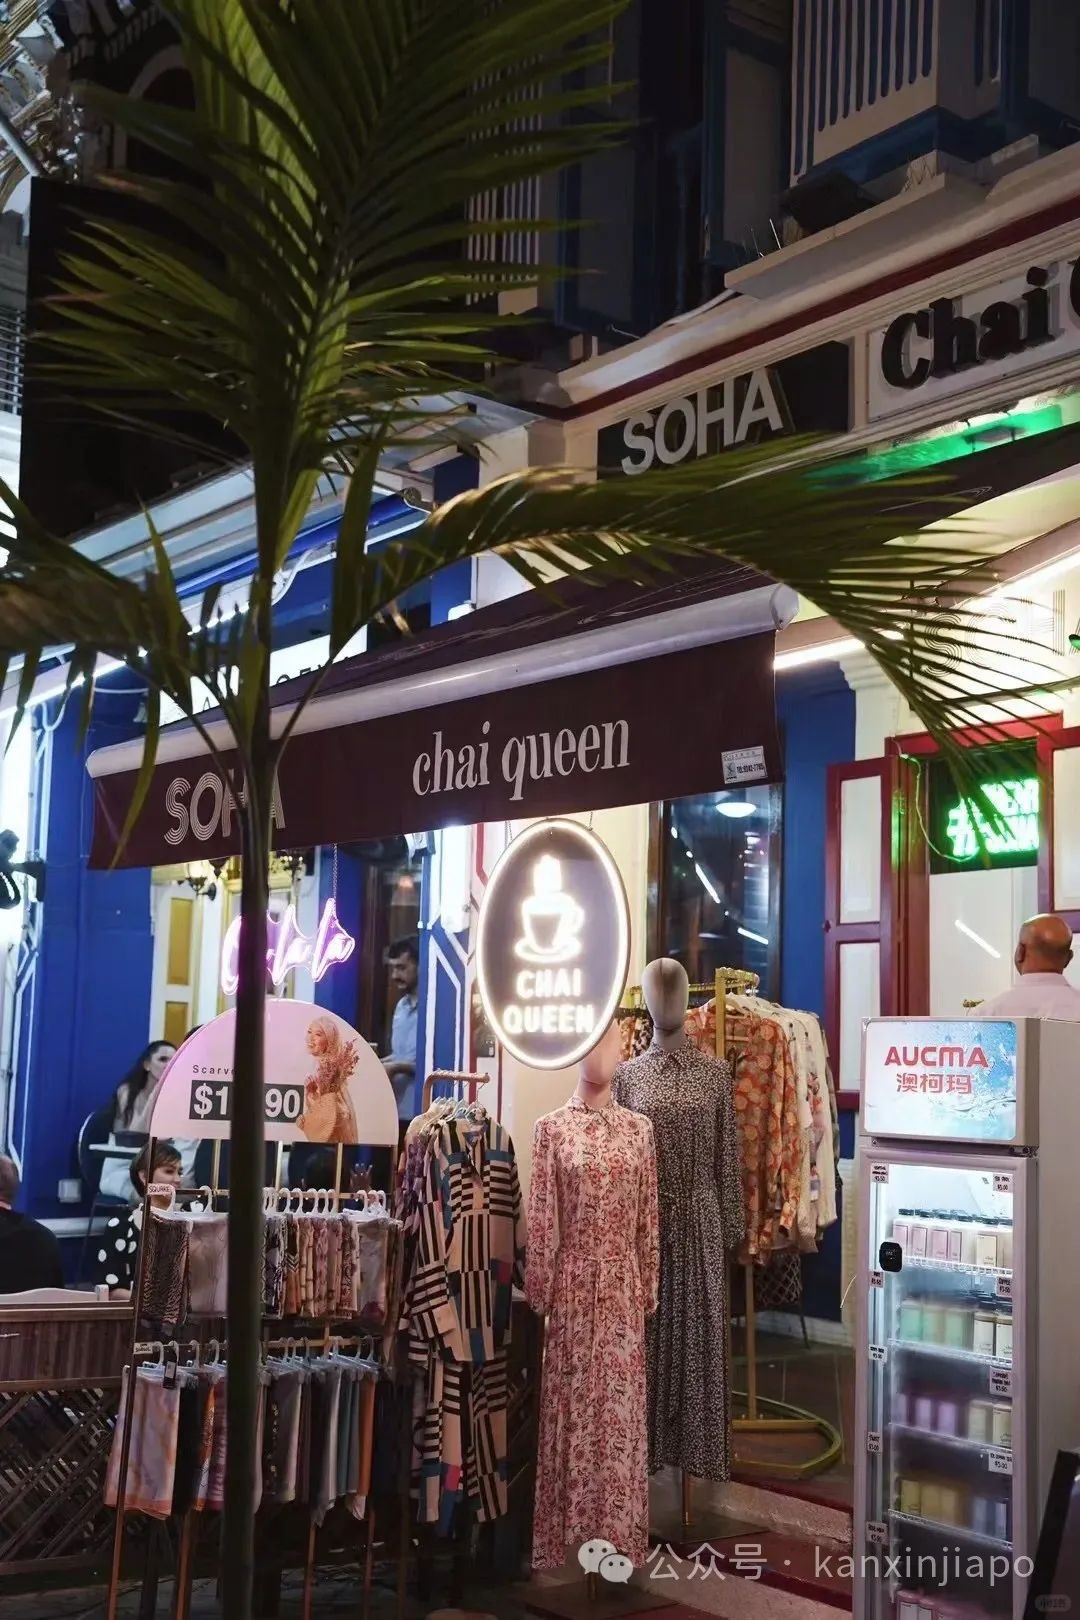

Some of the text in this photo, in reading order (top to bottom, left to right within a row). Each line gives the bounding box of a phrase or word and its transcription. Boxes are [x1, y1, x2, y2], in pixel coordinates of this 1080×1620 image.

[881, 266, 1057, 390] Chai
[621, 367, 784, 476] SOHA
[412, 719, 631, 801] chai queen
[516, 967, 582, 999] CHAI
[503, 1004, 595, 1034] QUEEN
[884, 1046, 989, 1068] AUCMA
[896, 1072, 973, 1095] 澳柯玛
